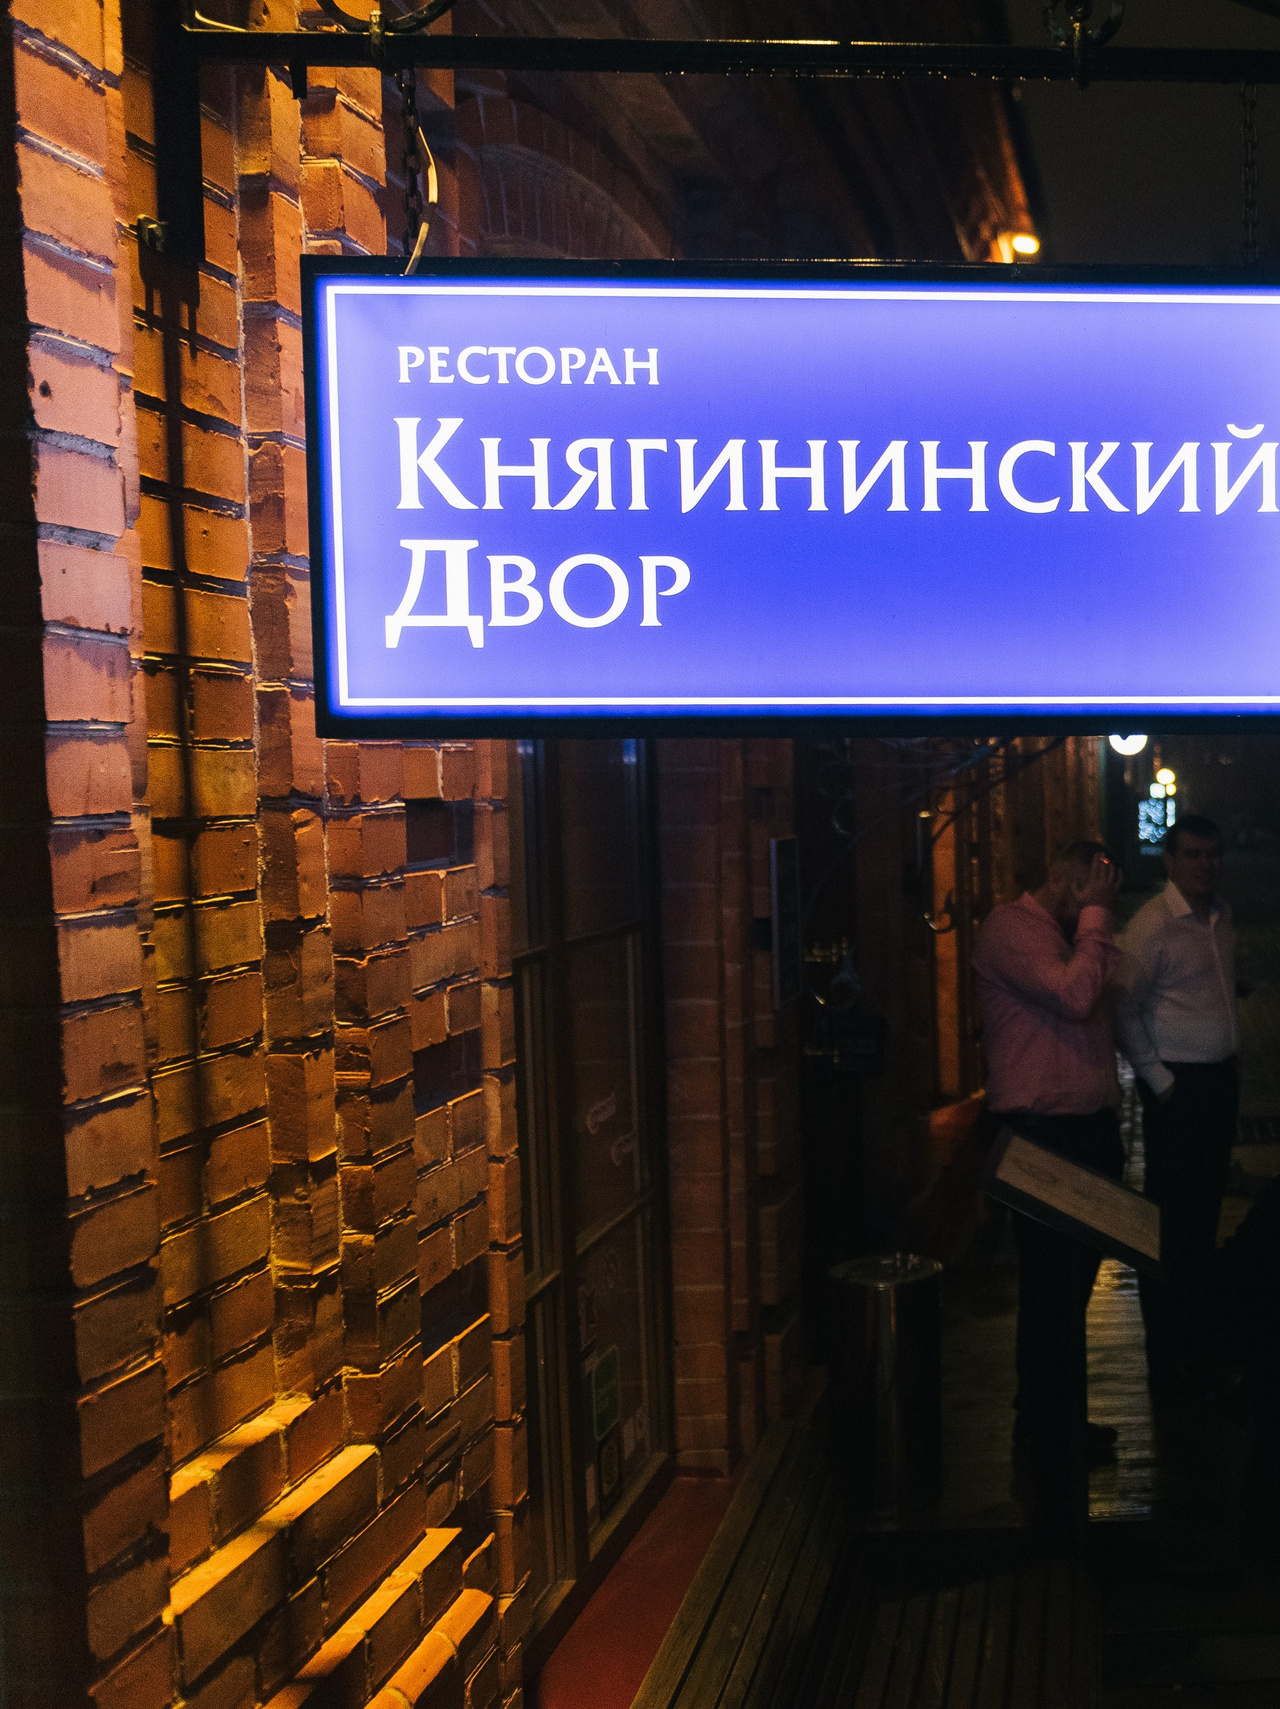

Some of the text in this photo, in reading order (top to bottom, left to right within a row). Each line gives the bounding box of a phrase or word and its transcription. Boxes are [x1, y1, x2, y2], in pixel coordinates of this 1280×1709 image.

[397, 345, 660, 385] РЕСТОРАН
[392, 416, 1280, 516] КНЯГИНИНСКИЙ
[384, 538, 692, 649] ДВОР
